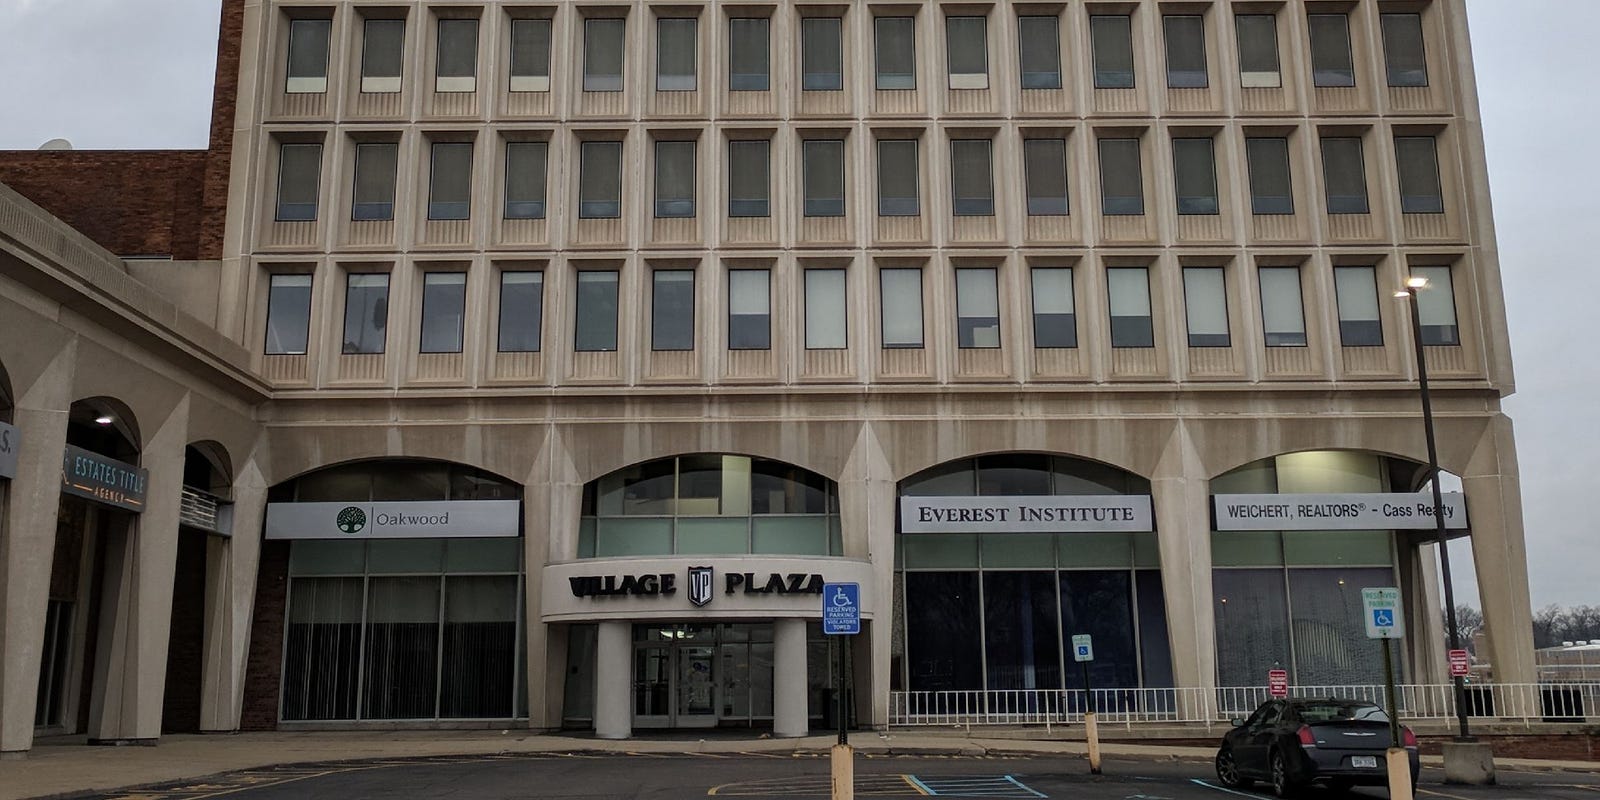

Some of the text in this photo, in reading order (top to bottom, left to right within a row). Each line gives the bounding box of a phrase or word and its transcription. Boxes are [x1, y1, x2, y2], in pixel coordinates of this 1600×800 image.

[75, 456, 144, 494] ESTATES TITLE
[94, 486, 124, 502] AGENCY
[376, 512, 449, 526] Oakwood
[1227, 505, 1293, 520] WEICHERT,
[1382, 504, 1413, 517] Cass
[1417, 504, 1454, 519] Reaty
[568, 572, 825, 597] VILLAGE PLAZA
[691, 573, 709, 600] VP
